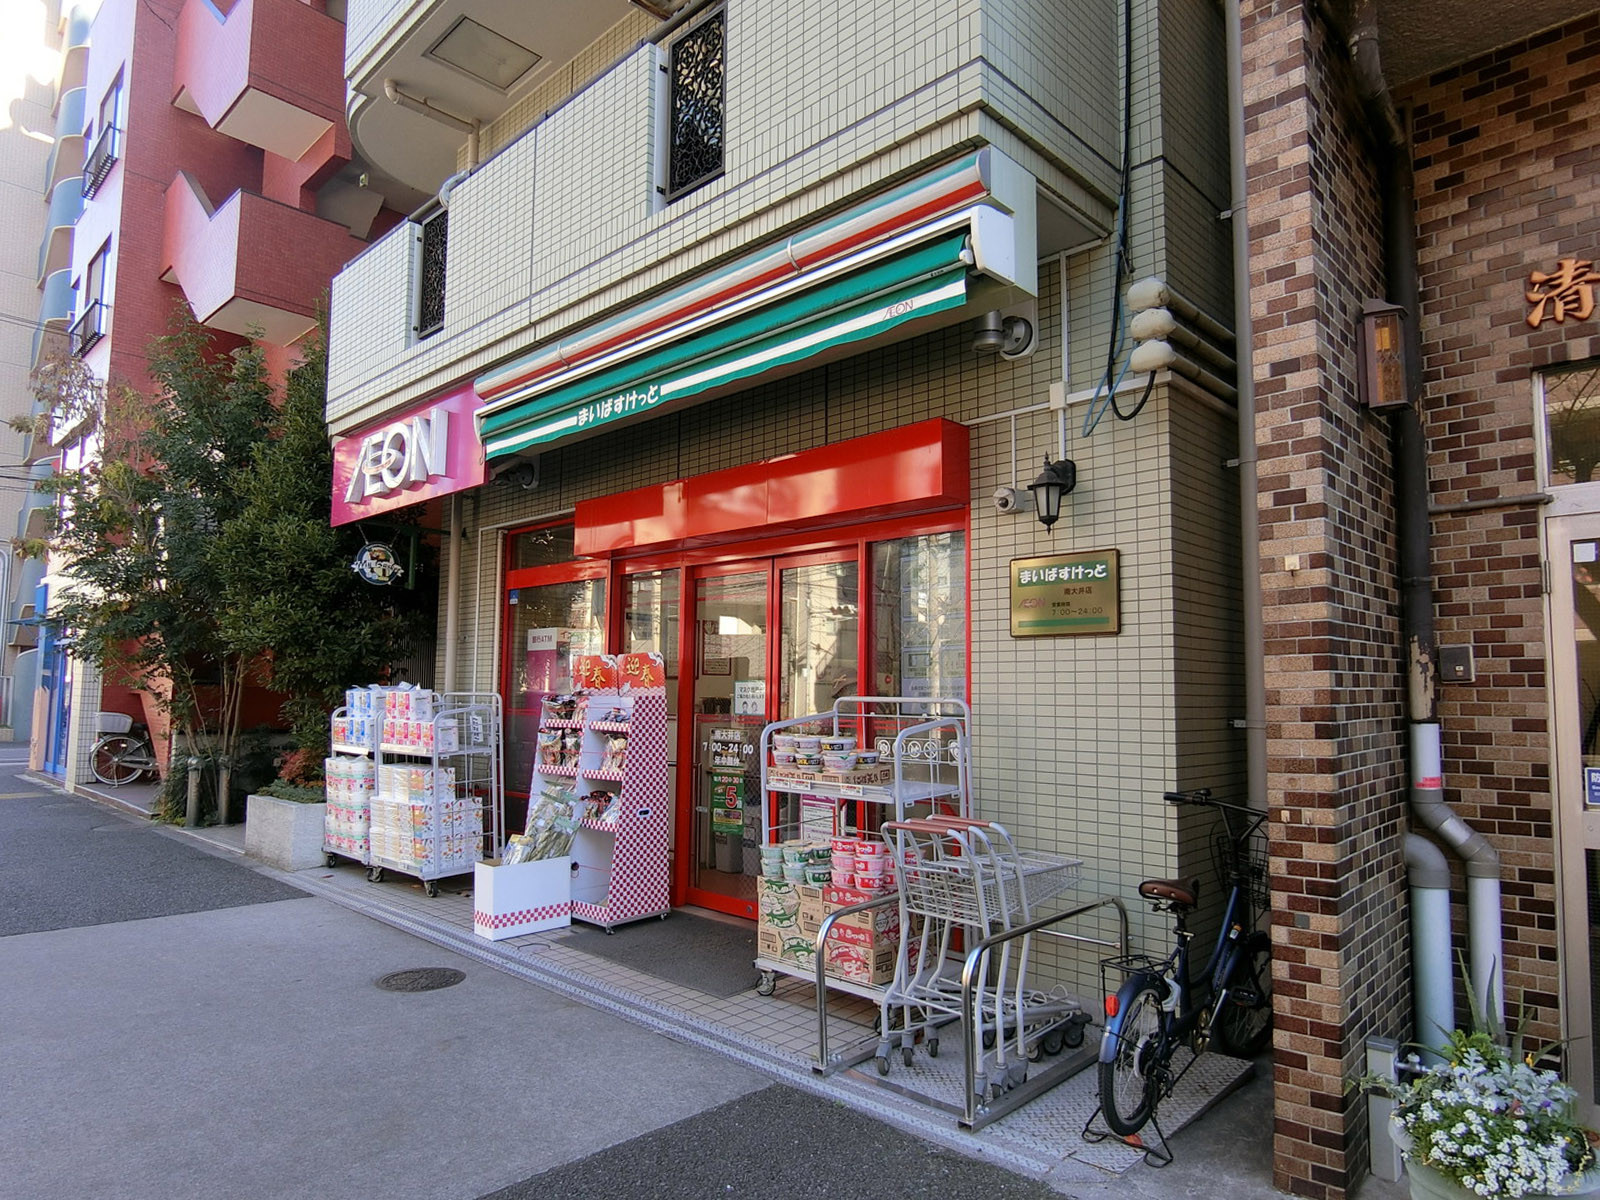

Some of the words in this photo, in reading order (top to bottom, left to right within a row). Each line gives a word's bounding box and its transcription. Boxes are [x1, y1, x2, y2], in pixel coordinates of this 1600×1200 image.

[1525, 257, 1600, 330] 清
[577, 384, 659, 427] まいばすけっと
[1019, 563, 1107, 584] まいばすけっと
